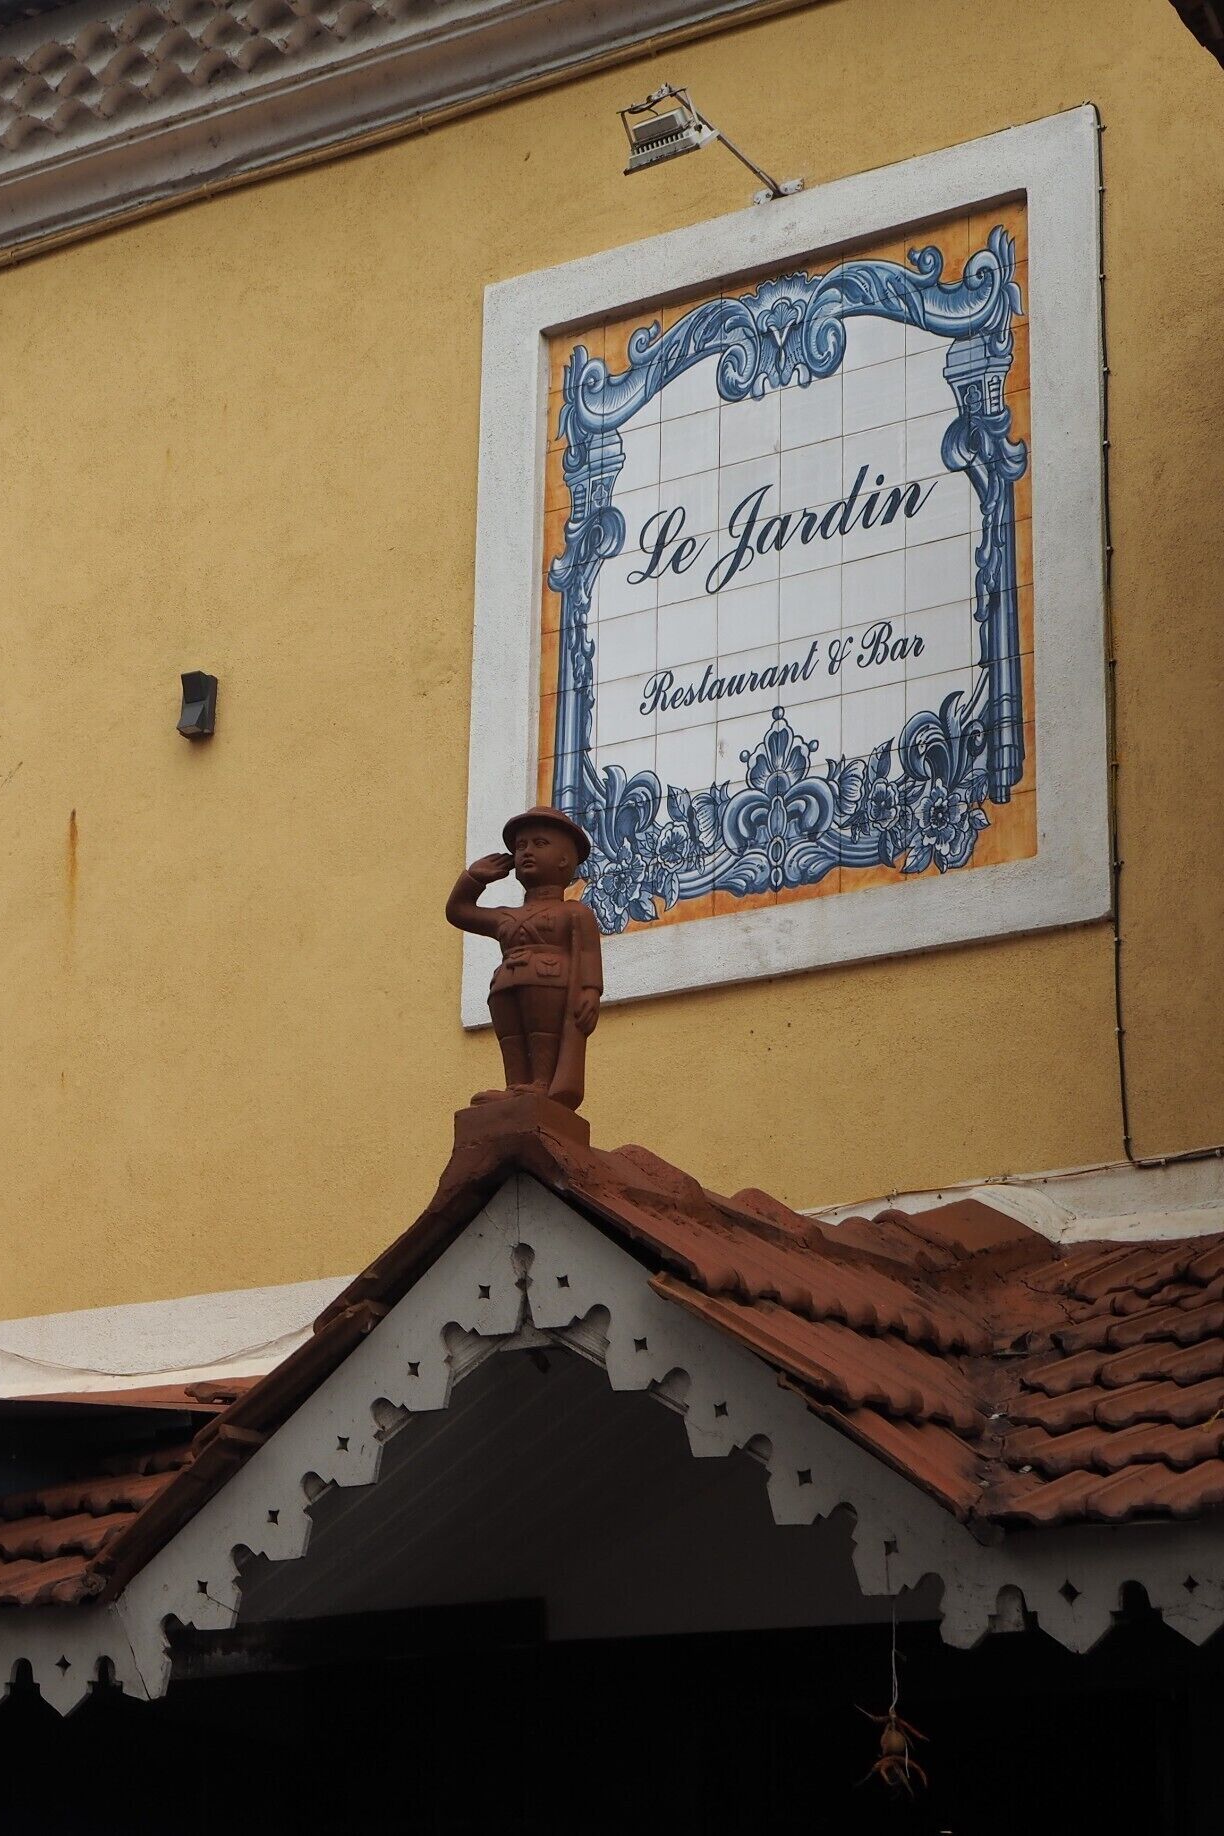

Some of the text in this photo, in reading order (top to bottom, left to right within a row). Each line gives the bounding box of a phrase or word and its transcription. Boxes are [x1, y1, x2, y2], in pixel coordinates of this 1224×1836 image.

[626, 464, 939, 595] Le Jardin
[639, 621, 926, 716] Restaurant & Bar
